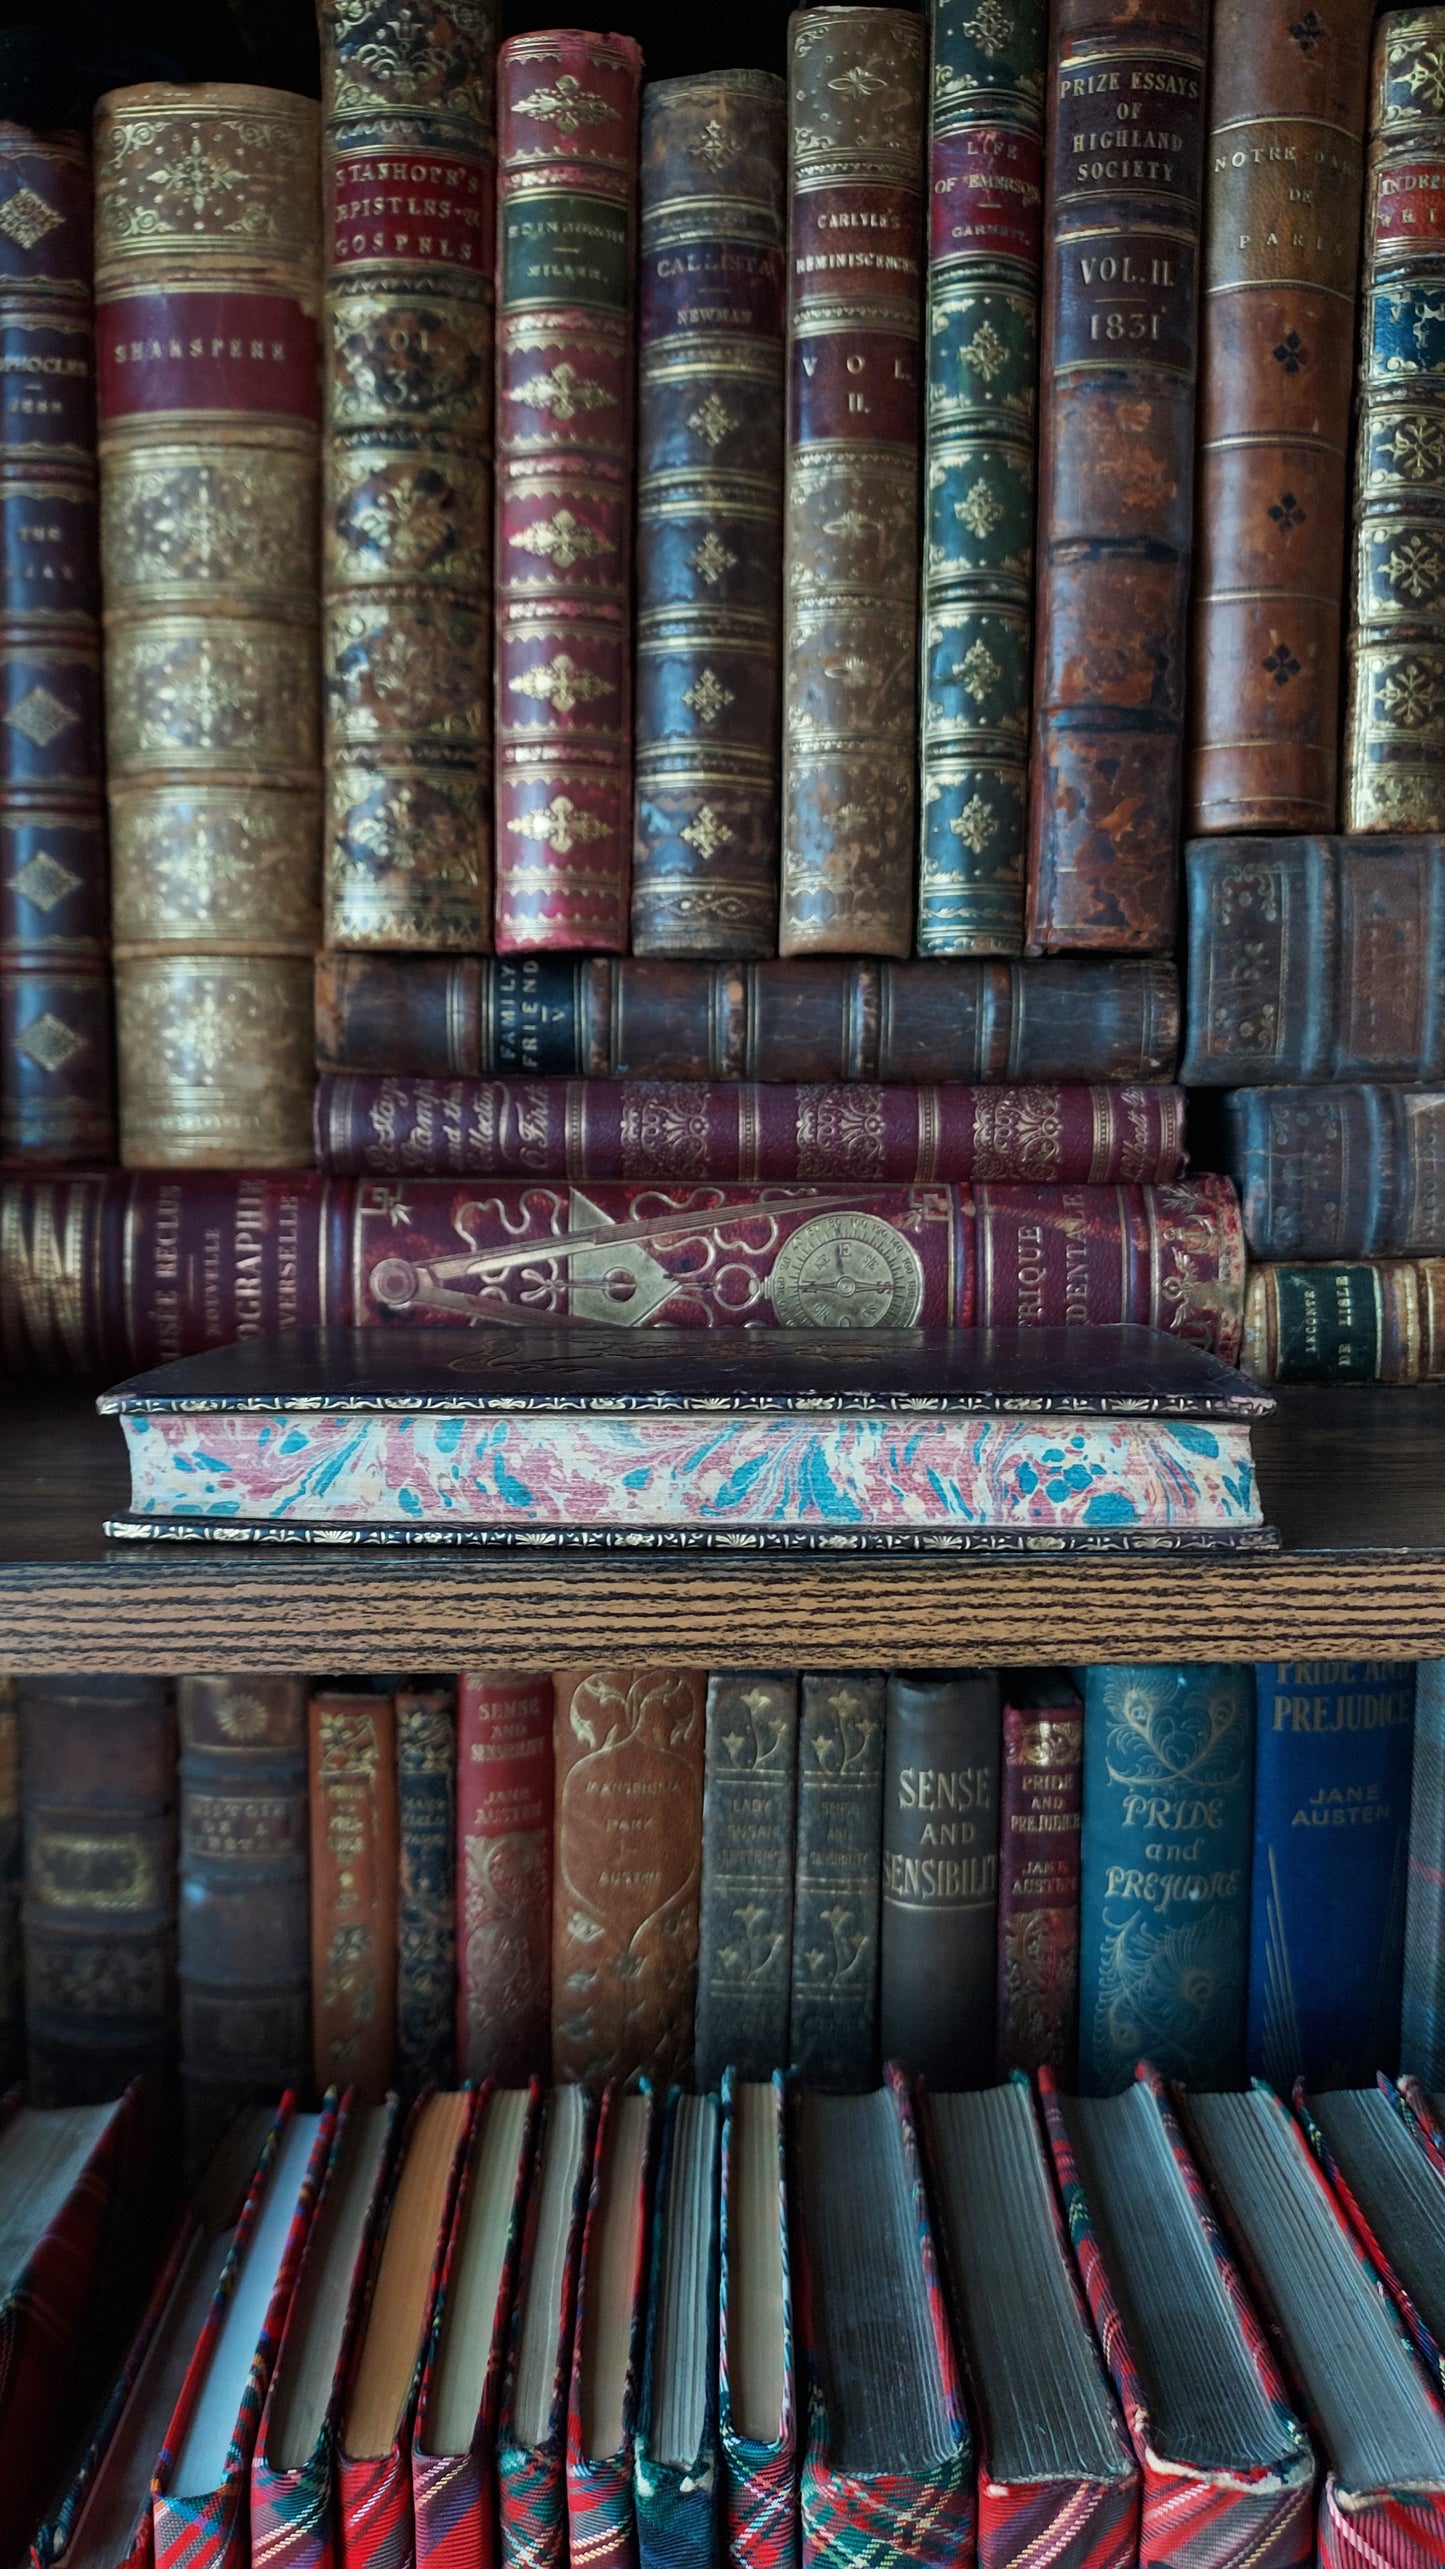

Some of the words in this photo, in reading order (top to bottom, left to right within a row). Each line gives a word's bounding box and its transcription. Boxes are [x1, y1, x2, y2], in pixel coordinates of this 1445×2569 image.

[1059, 72, 1121, 99] PRIZE
[1130, 72, 1199, 99] ESSAYS
[1116, 102, 1142, 120] OF
[1073, 129, 1183, 153] HIGHLAND
[1077, 160, 1175, 182] SOCIETY
[935, 177, 957, 194] OF
[1289, 188, 1313, 203] DE
[335, 232, 473, 260] GOSPELS
[1090, 313, 1159, 340] 1831
[500, 964, 517, 1059] FAMILY
[521, 960, 539, 1068] FRIEND
[551, 1007, 566, 1022] V
[153, 1185, 182, 1279] RECLUS
[1336, 1343, 1352, 1367] DE
[478, 1698, 540, 1720] SENSE
[1272, 1689, 1413, 1732] PREJUDICE
[898, 1766, 992, 1812] SENSE
[1022, 1774, 1074, 1791] PRIDE
[1309, 1783, 1382, 1805] JANE
[1031, 1796, 1066, 1809] AND
[1121, 1793, 1225, 1831] PRIDE
[1291, 1801, 1392, 1827] AUSTEN
[920, 1821, 976, 1846] AND
[1144, 1836, 1206, 1862] and
[1104, 1865, 1240, 1914] PREJUDICE
